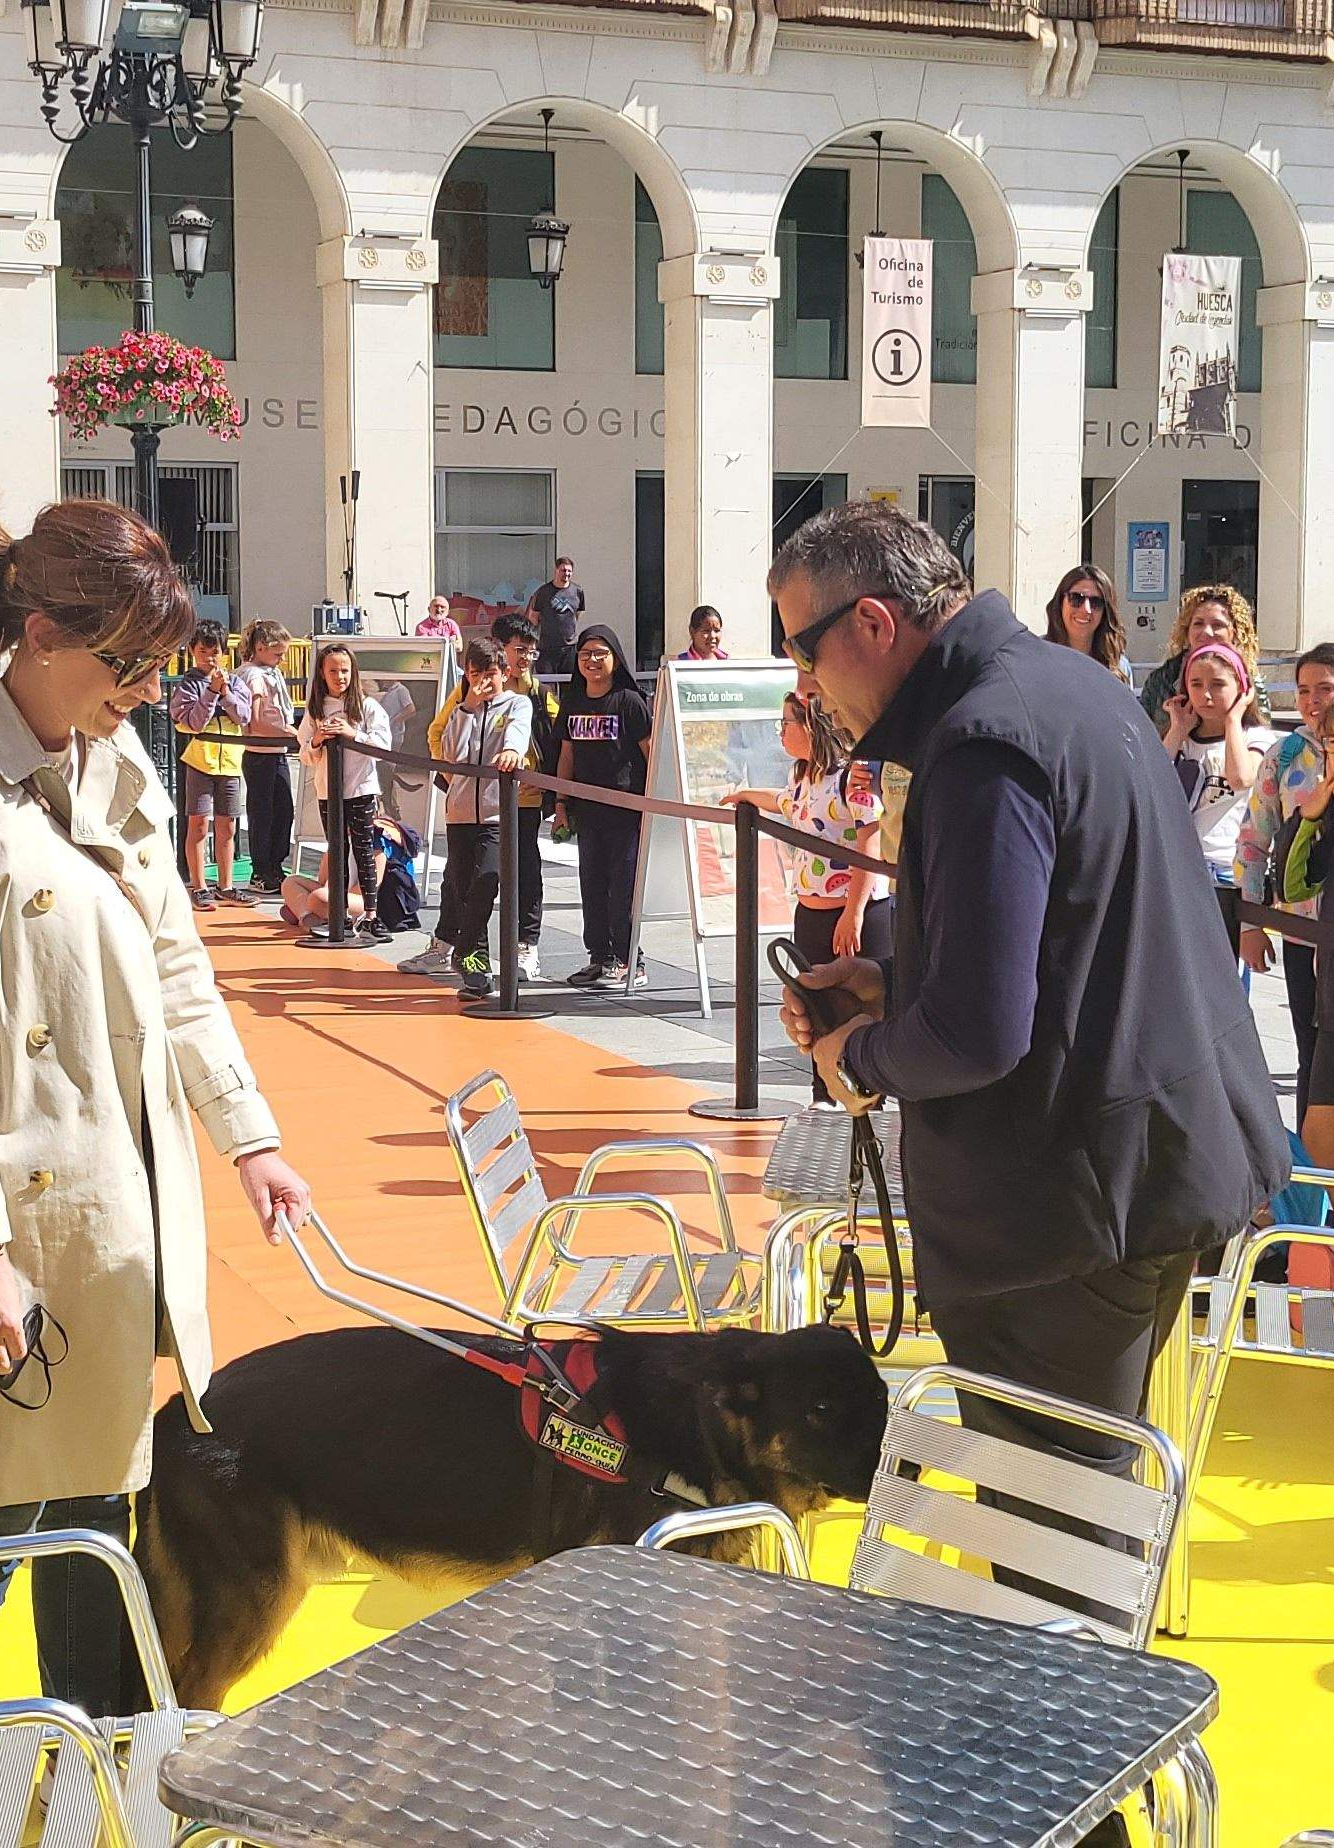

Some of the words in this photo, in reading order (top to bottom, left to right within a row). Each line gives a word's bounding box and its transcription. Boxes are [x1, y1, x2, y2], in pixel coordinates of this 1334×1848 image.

[878, 257, 924, 272] Oficina
[907, 276, 924, 289] de
[871, 291, 923, 306] Turismo
[1197, 292, 1233, 312] HUESCA
[433, 400, 666, 437] EDAGÓGIC
[1082, 420, 1207, 450] FICINA
[686, 691, 707, 703] Zona
[708, 691, 719, 702] de
[720, 690, 744, 702] obras
[568, 715, 618, 739] MARVEL
[564, 1446, 593, 1461] PERRO
[584, 1442, 618, 1462] ONCE
